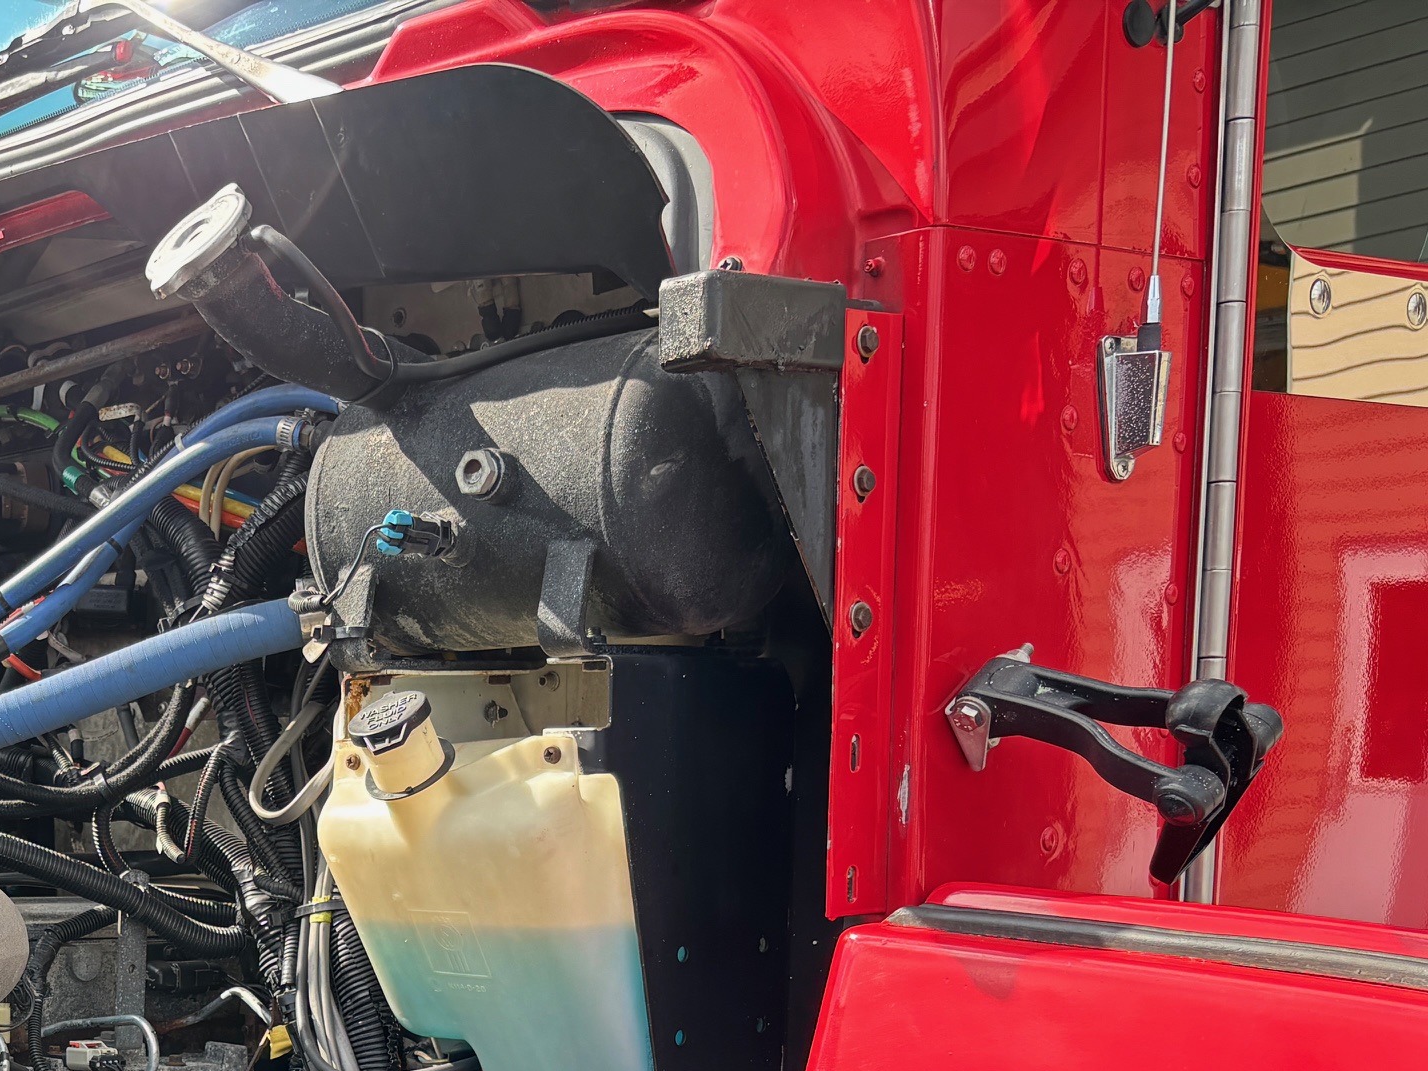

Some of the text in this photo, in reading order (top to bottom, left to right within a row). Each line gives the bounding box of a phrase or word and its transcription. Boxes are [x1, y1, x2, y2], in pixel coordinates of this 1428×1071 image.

[361, 693, 418, 720] WASHER
[367, 706, 407, 725] FLUID
[369, 713, 403, 730] ONLY
